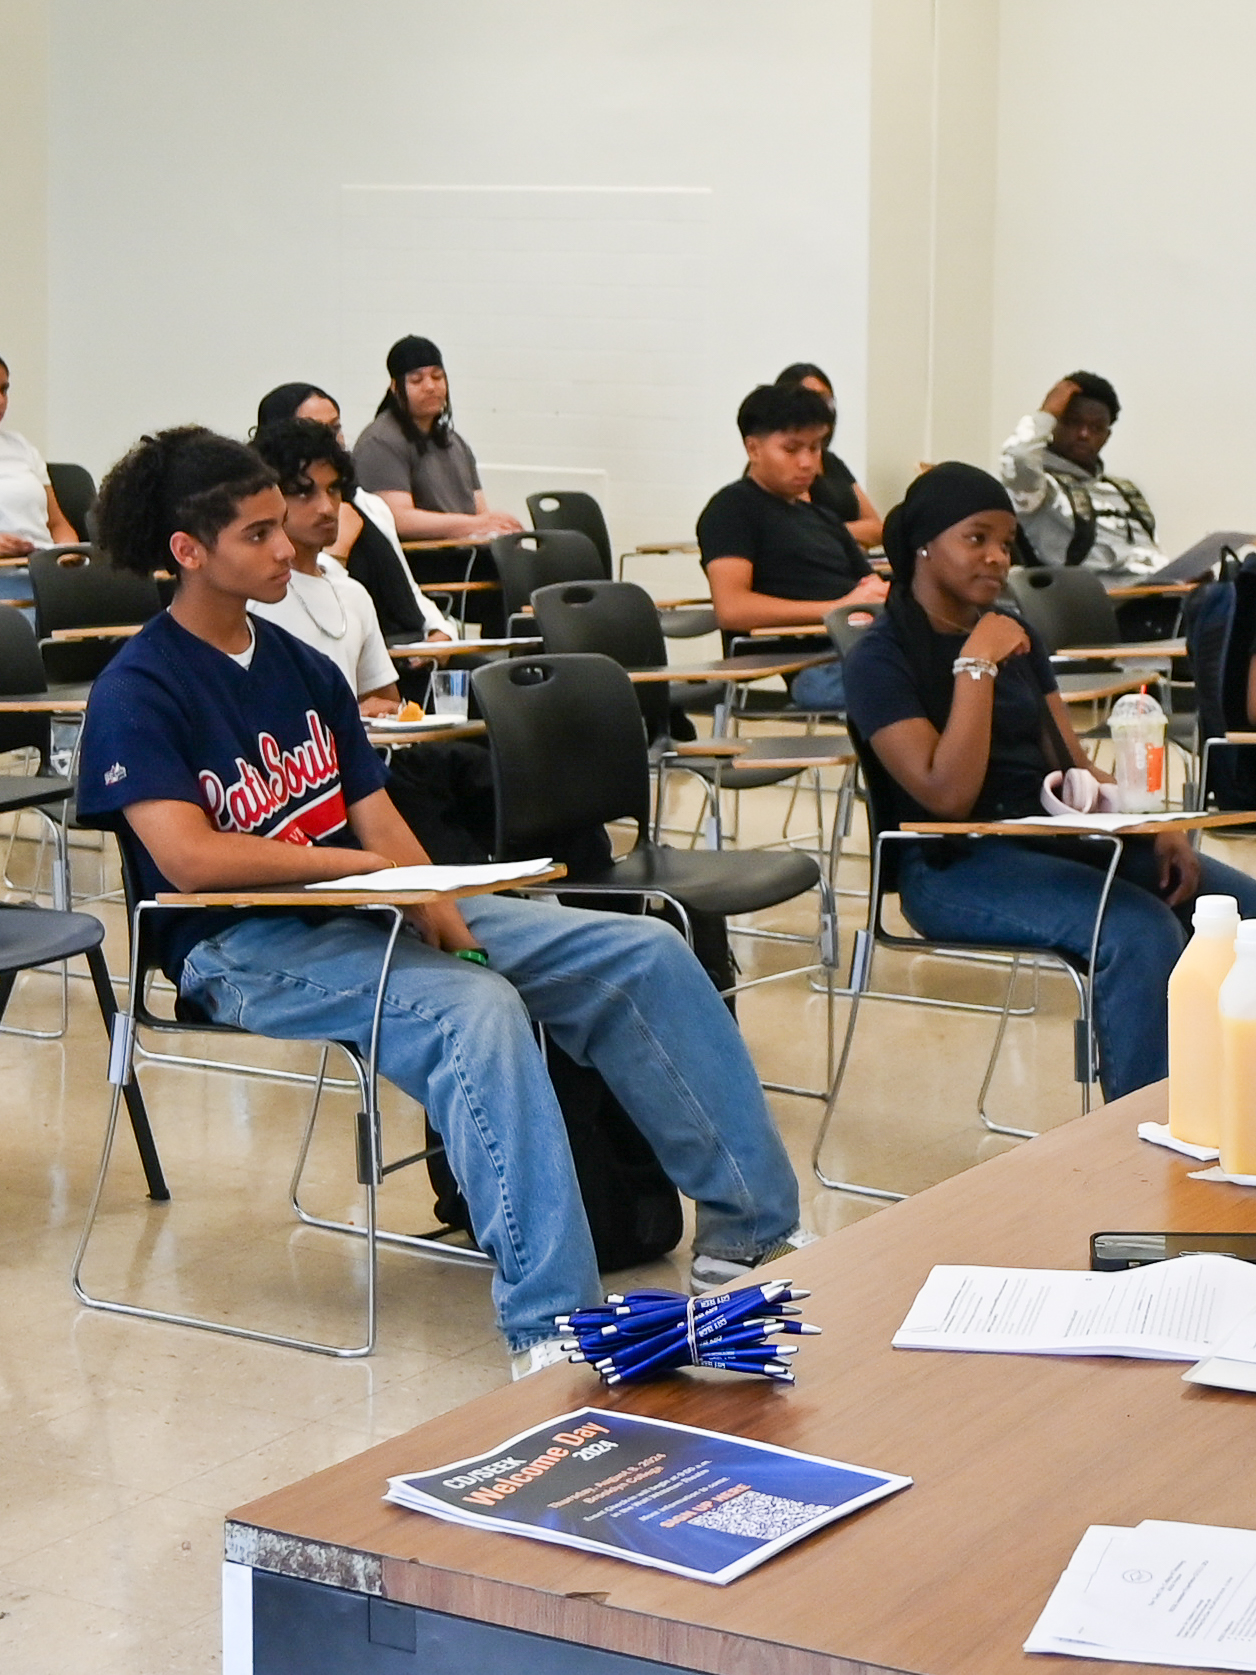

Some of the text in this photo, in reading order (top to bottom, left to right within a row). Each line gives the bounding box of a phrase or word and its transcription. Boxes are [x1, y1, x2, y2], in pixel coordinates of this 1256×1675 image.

[462, 1421, 611, 1506] Welcome Day
[572, 1439, 619, 1461] 2024
[442, 1455, 528, 1490] CD/SEEK
[691, 1500, 714, 1512] UP
[711, 1483, 752, 1503] HERE
